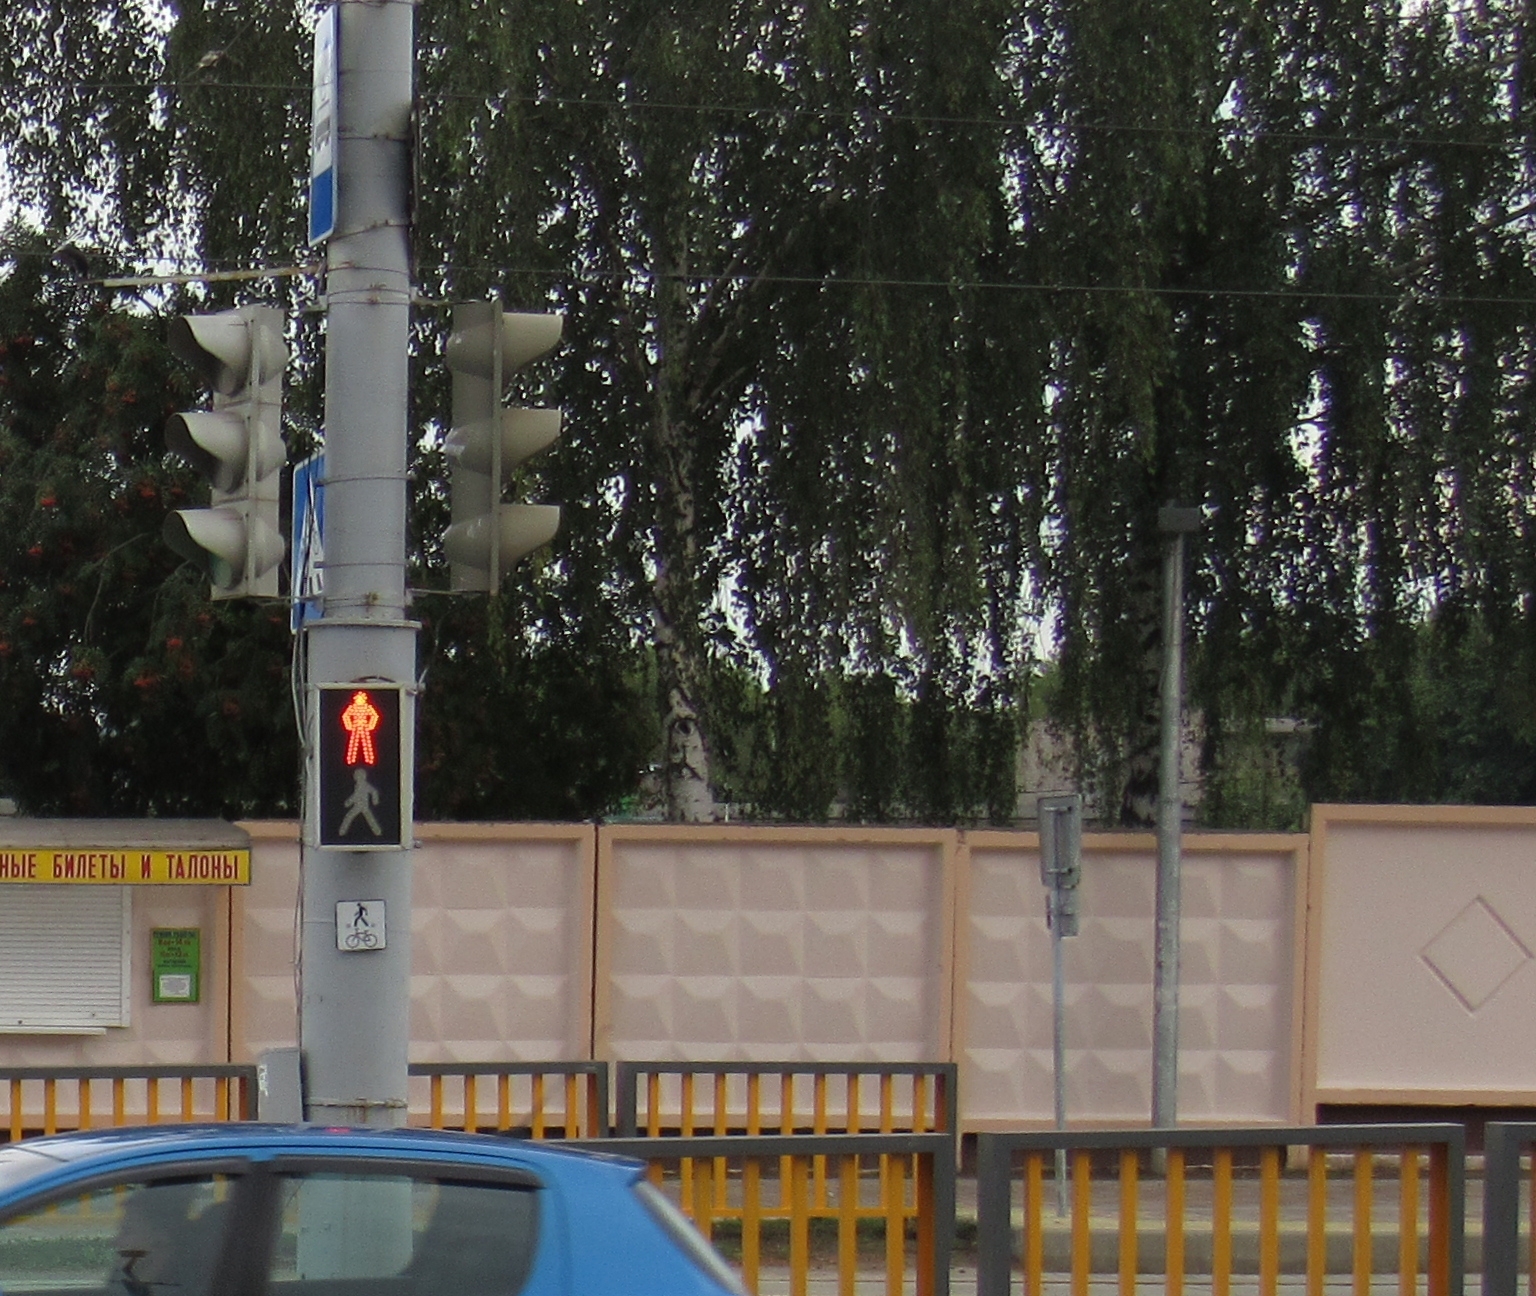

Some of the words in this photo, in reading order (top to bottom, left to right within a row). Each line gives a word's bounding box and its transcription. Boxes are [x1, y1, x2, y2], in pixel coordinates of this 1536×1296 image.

[52, 853, 125, 879] БИЛЕТЫ
[141, 854, 151, 878] И
[167, 853, 239, 879] ТАЛОНЫ
